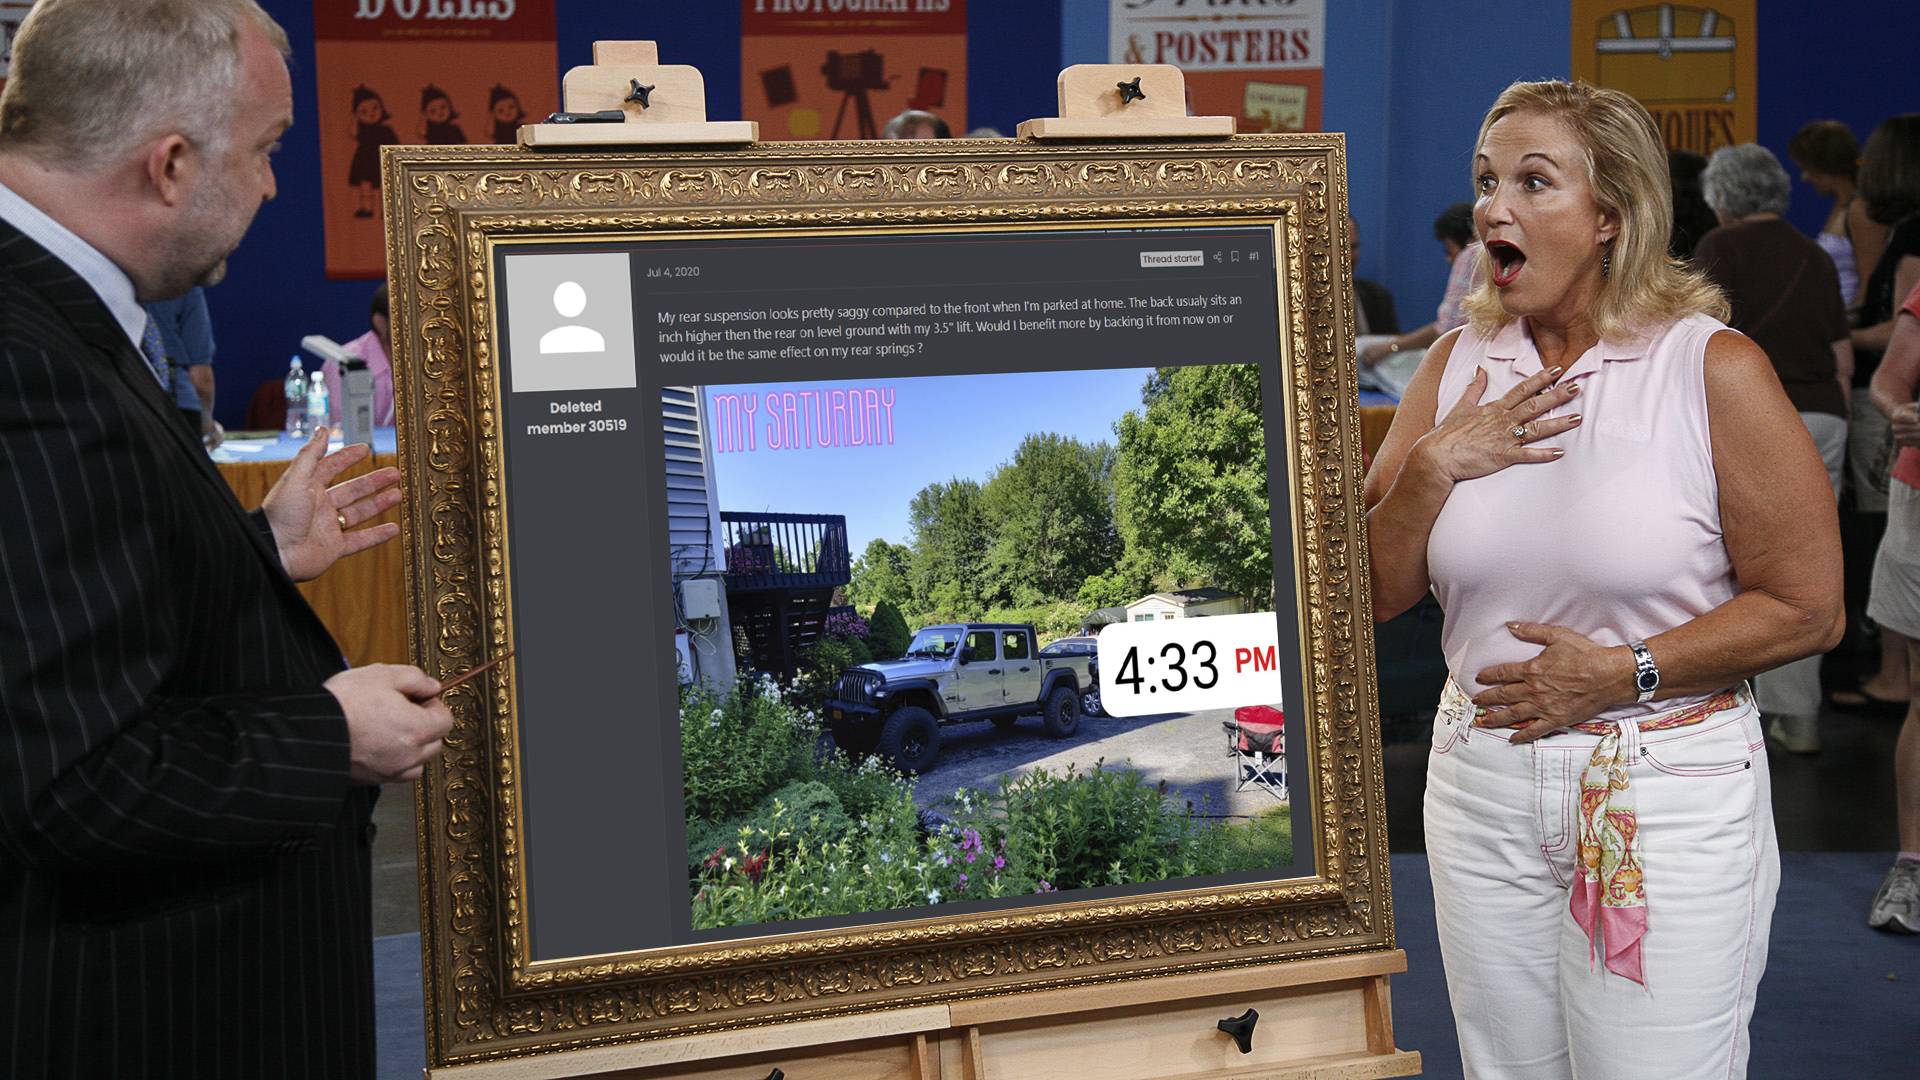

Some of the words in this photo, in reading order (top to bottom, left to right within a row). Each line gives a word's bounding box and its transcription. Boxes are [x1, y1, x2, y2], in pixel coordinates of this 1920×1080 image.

[1154, 28, 1310, 64] POSTERS
[1143, 255, 1172, 264] Thread
[1174, 254, 1200, 263] starter
[1248, 251, 1260, 261] #1
[646, 267, 662, 278] Jul
[663, 267, 673, 279] 4,
[674, 266, 700, 277] 2020
[657, 311, 676, 327] My
[678, 312, 702, 323] rear
[703, 308, 767, 325] suspension
[769, 307, 800, 320] looks
[801, 307, 835, 322] pretty
[837, 307, 870, 321] saggy
[871, 303, 927, 319] compared
[928, 303, 942, 315] to
[943, 302, 962, 315] the
[963, 301, 991, 314] front
[991, 300, 1021, 313] when
[1042, 298, 1079, 314] parked
[1081, 299, 1092, 310] at
[1093, 297, 1127, 310] home.
[1127, 296, 1148, 308] The
[1149, 295, 1175, 308] back
[1210, 293, 1228, 306] sits
[1229, 296, 1243, 305] an
[658, 330, 683, 343] inch
[685, 329, 723, 345] higher
[724, 328, 751, 341] then
[753, 327, 773, 340] the
[774, 329, 797, 339] rear
[799, 328, 815, 339] on
[816, 325, 842, 338] level
[845, 323, 886, 340] ground
[887, 322, 912, 335] with
[913, 324, 931, 337] my
[956, 320, 974, 333] lift.
[975, 319, 1011, 333] Would
[1019, 317, 1057, 331] benefit
[1058, 319, 1086, 329] more
[1088, 316, 1102, 331] by
[1103, 315, 1144, 330] backing
[1145, 314, 1154, 327] it
[1155, 314, 1181, 326] from
[1182, 315, 1205, 325] now
[1206, 315, 1221, 325] on
[1222, 314, 1234, 324] or
[659, 349, 695, 363] would
[697, 349, 706, 362] it
[708, 348, 724, 361] be
[725, 348, 745, 361] the
[747, 349, 777, 360] same
[779, 345, 812, 359] effect
[813, 347, 829, 358] on
[831, 346, 849, 360] my
[850, 345, 873, 356] rear
[875, 342, 916, 358] springs
[550, 400, 602, 414] Deleted
[527, 421, 586, 435] member
[588, 418, 627, 432] 30519
